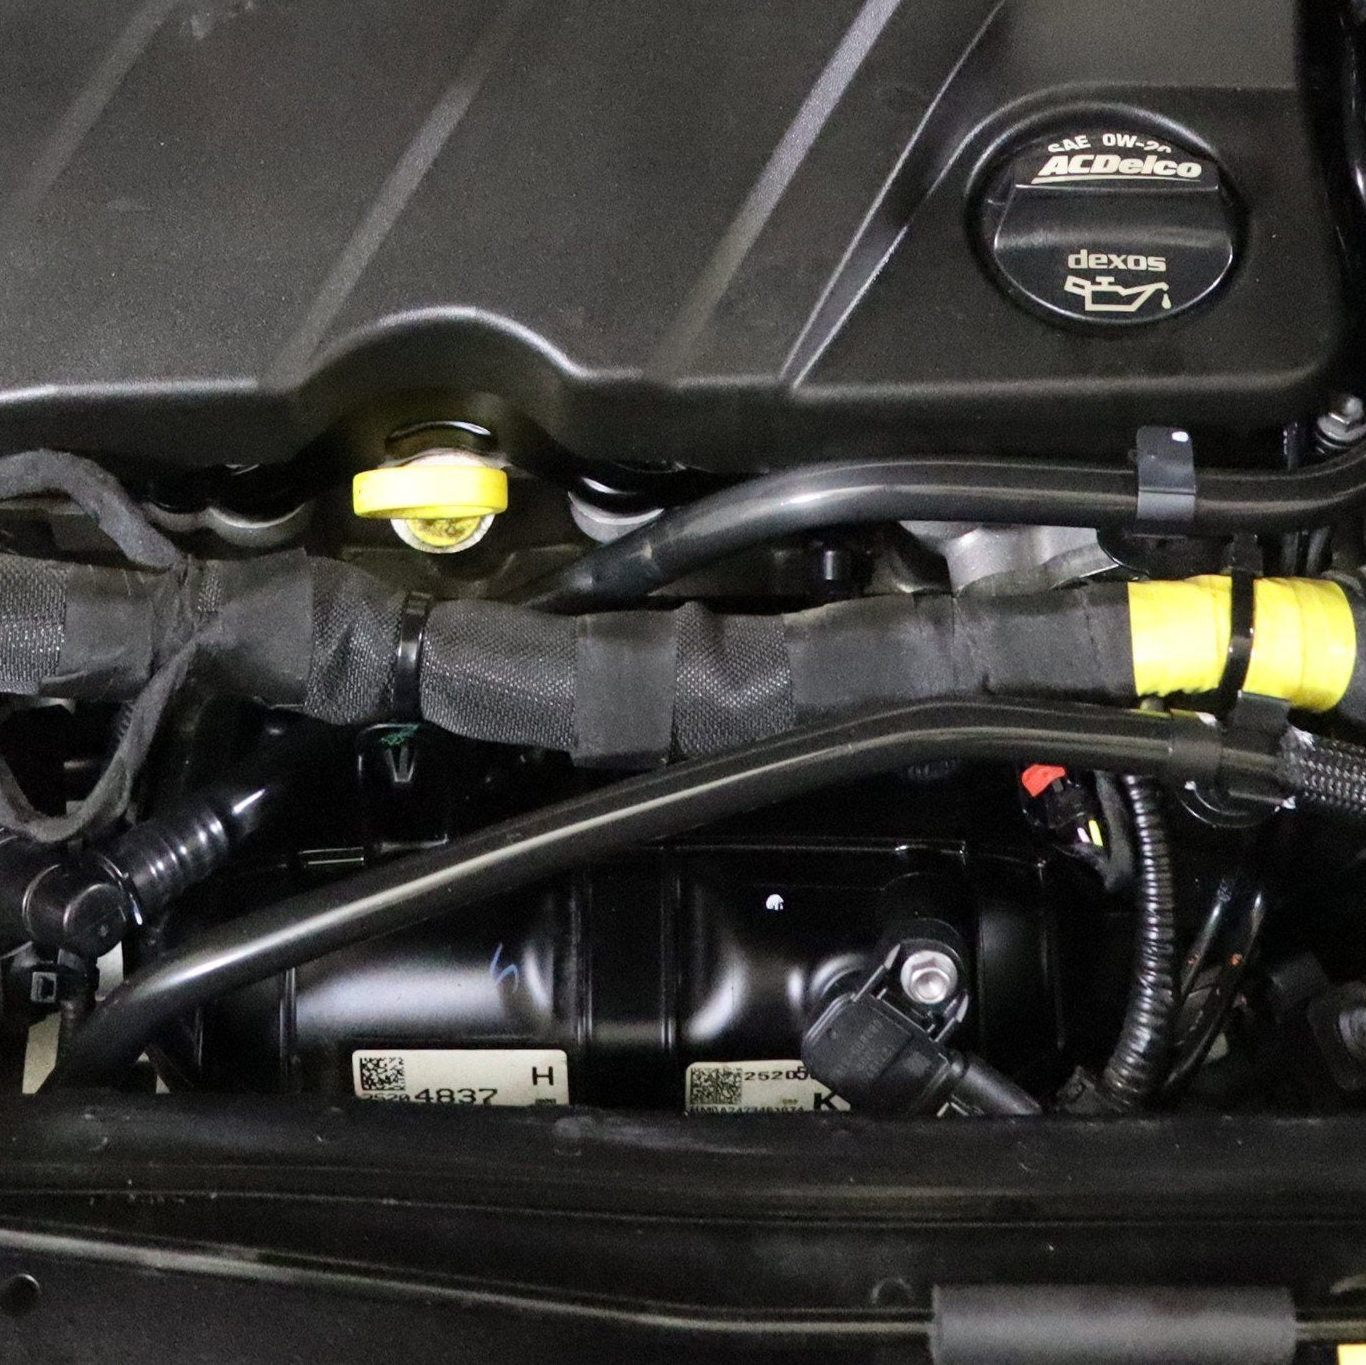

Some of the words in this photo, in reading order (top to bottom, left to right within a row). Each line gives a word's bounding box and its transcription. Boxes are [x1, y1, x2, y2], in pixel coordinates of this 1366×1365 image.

[1048, 135, 1092, 153] SAE
[1036, 154, 1203, 178] ACDelco
[1067, 248, 1167, 272] dexos
[532, 1066, 555, 1086] H
